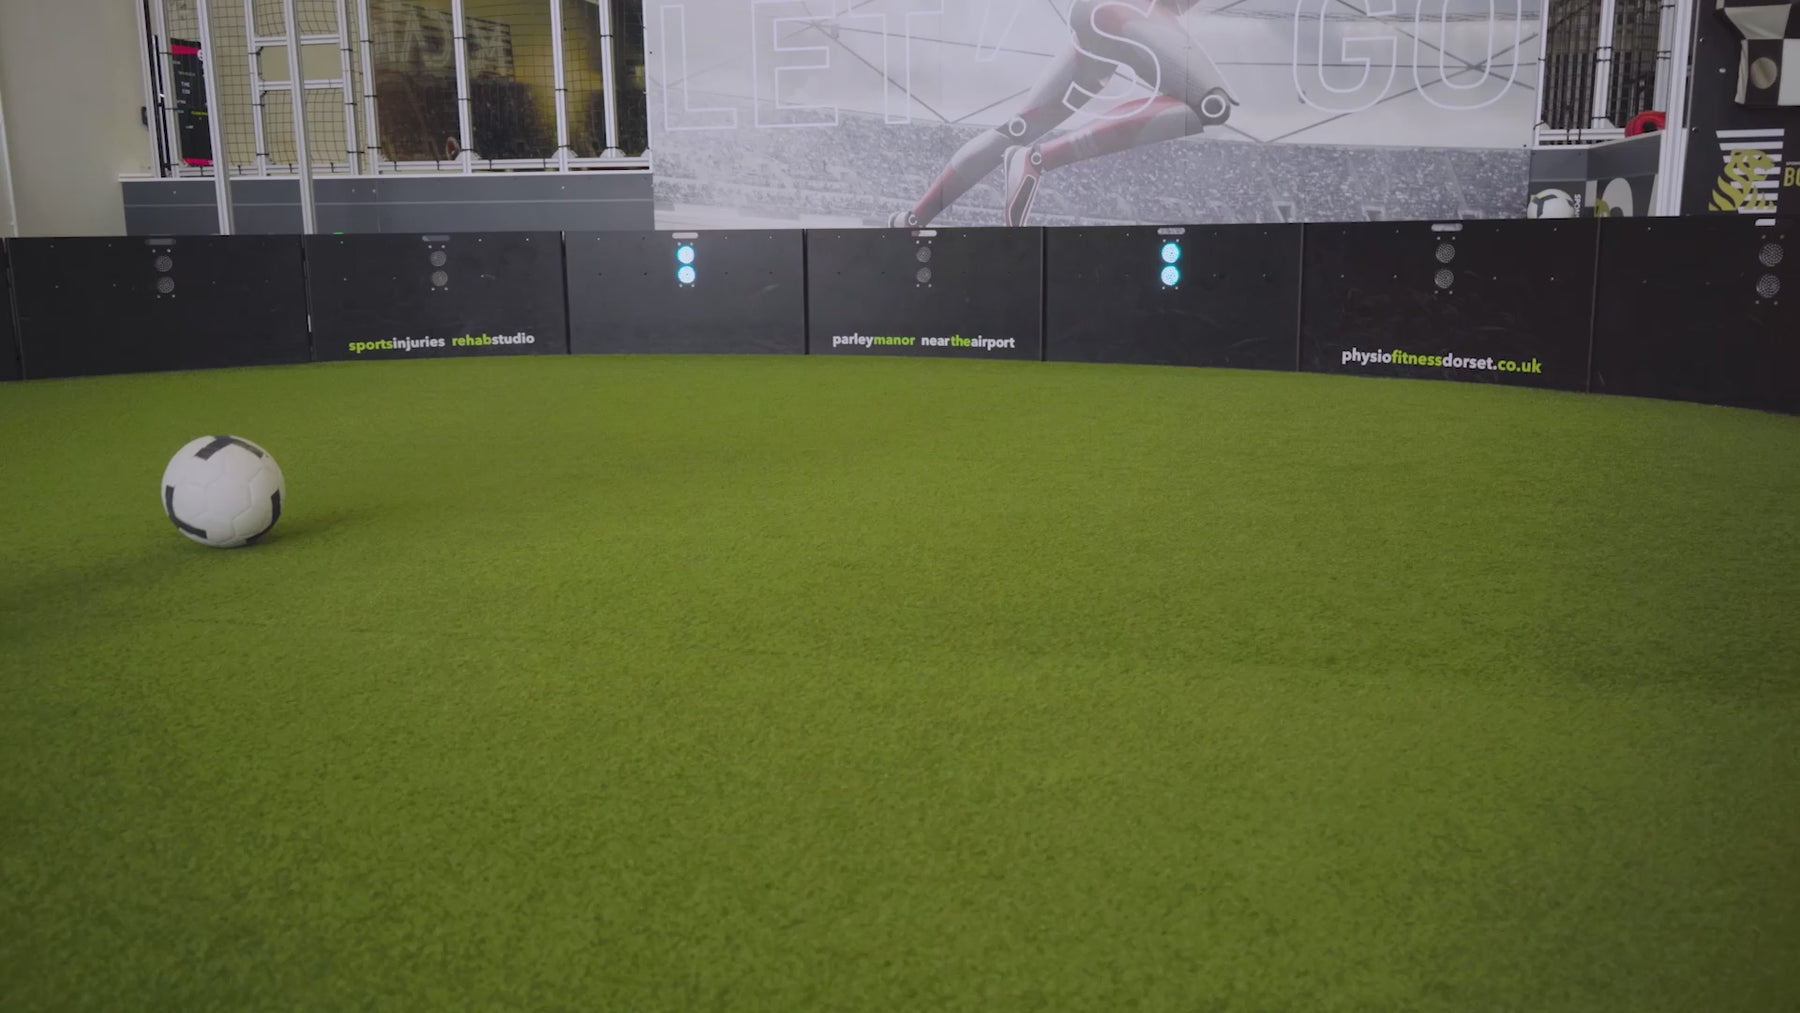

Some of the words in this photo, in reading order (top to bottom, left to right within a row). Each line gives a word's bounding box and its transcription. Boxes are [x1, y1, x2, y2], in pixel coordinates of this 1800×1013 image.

[661, 0, 1162, 131] LET'S
[1292, 0, 1522, 113] GO
[349, 336, 445, 353] sportsinjuries
[452, 332, 535, 346] rehabstudio
[832, 332, 915, 348] parleymanor
[921, 335, 1015, 351] neartheairport
[1342, 348, 1541, 373] physiofitnessdorset.co.uk
